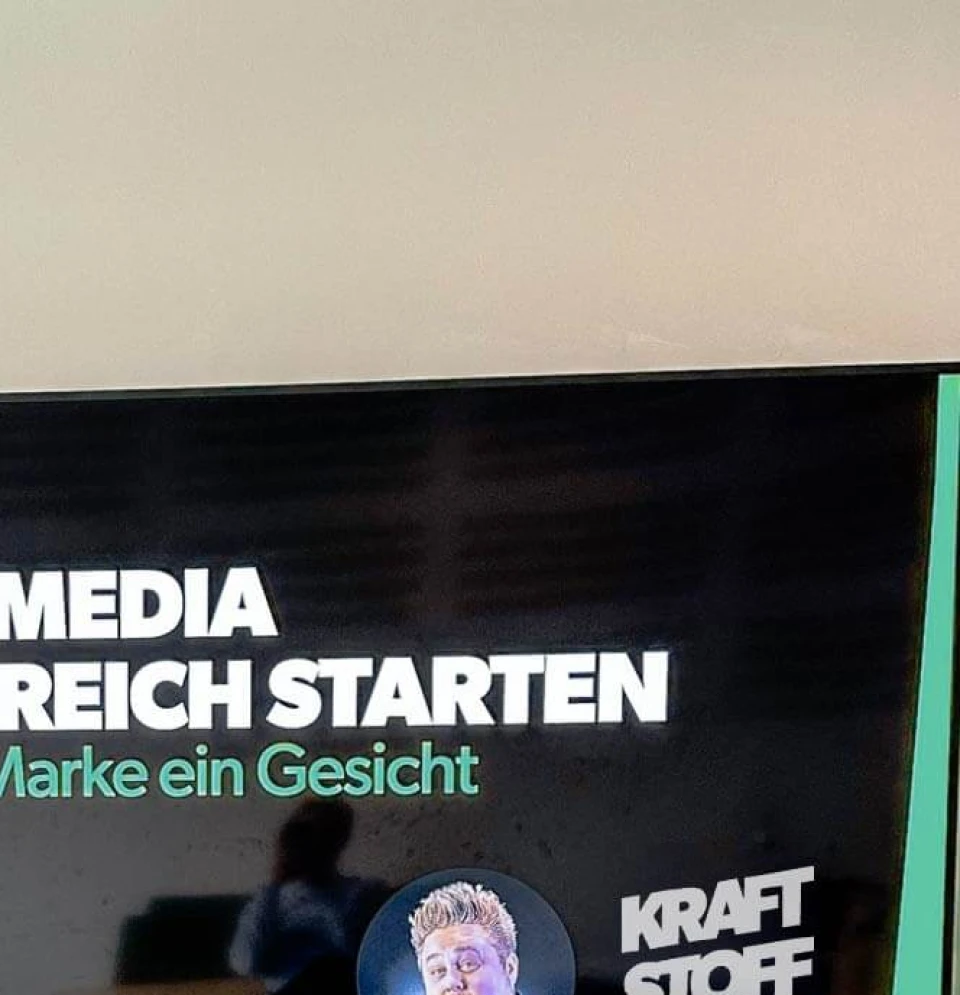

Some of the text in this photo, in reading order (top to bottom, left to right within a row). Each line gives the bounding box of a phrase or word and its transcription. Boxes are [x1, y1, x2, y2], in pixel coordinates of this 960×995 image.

[265, 650, 669, 729] STARTEN
[158, 744, 244, 798] ein
[257, 740, 479, 797] Gesicht
[621, 865, 815, 954] KRAFT
